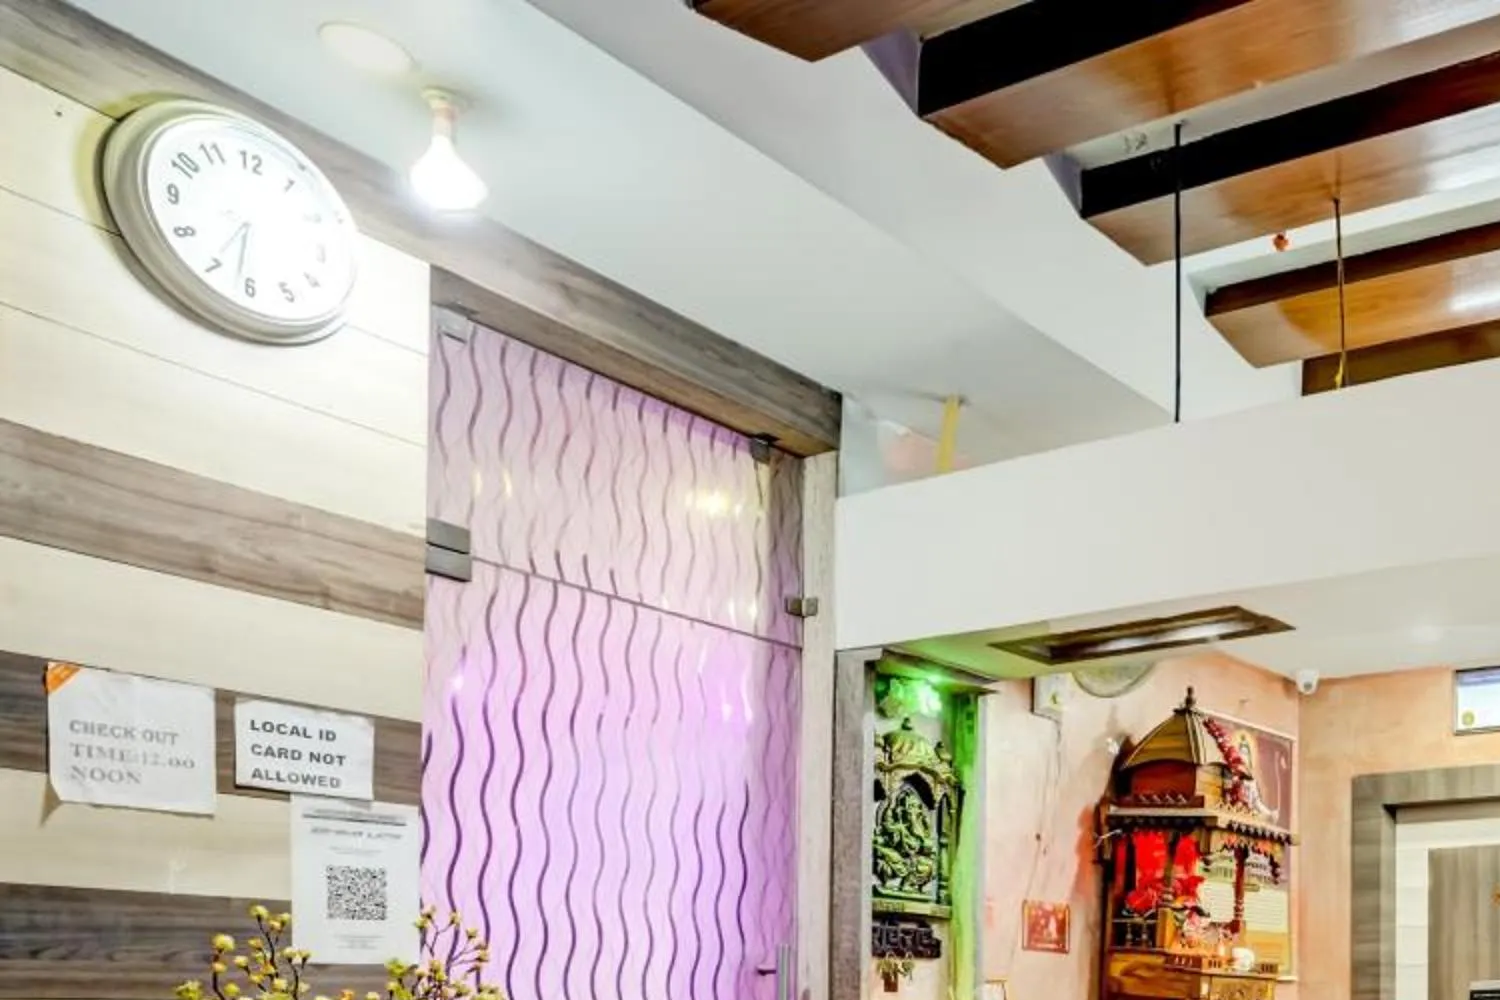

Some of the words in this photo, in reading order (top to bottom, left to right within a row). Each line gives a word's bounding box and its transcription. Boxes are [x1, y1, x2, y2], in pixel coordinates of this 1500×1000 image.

[198, 142, 227, 166] 11
[238, 149, 263, 176] 12
[170, 152, 201, 180] 10
[166, 182, 180, 206] 9
[172, 225, 197, 239] 8
[204, 257, 223, 274] 7
[244, 276, 257, 299] 6
[278, 281, 296, 303] 5
[69, 719, 136, 740] CHECK
[141, 729, 179, 746] OUT
[250, 719, 313, 739] LOCAL
[319, 728, 338, 742] ID
[250, 743, 303, 761] CARD
[309, 751, 347, 767] NOT
[69, 764, 142, 785] NOON
[251, 767, 342, 789] ALLOWED
